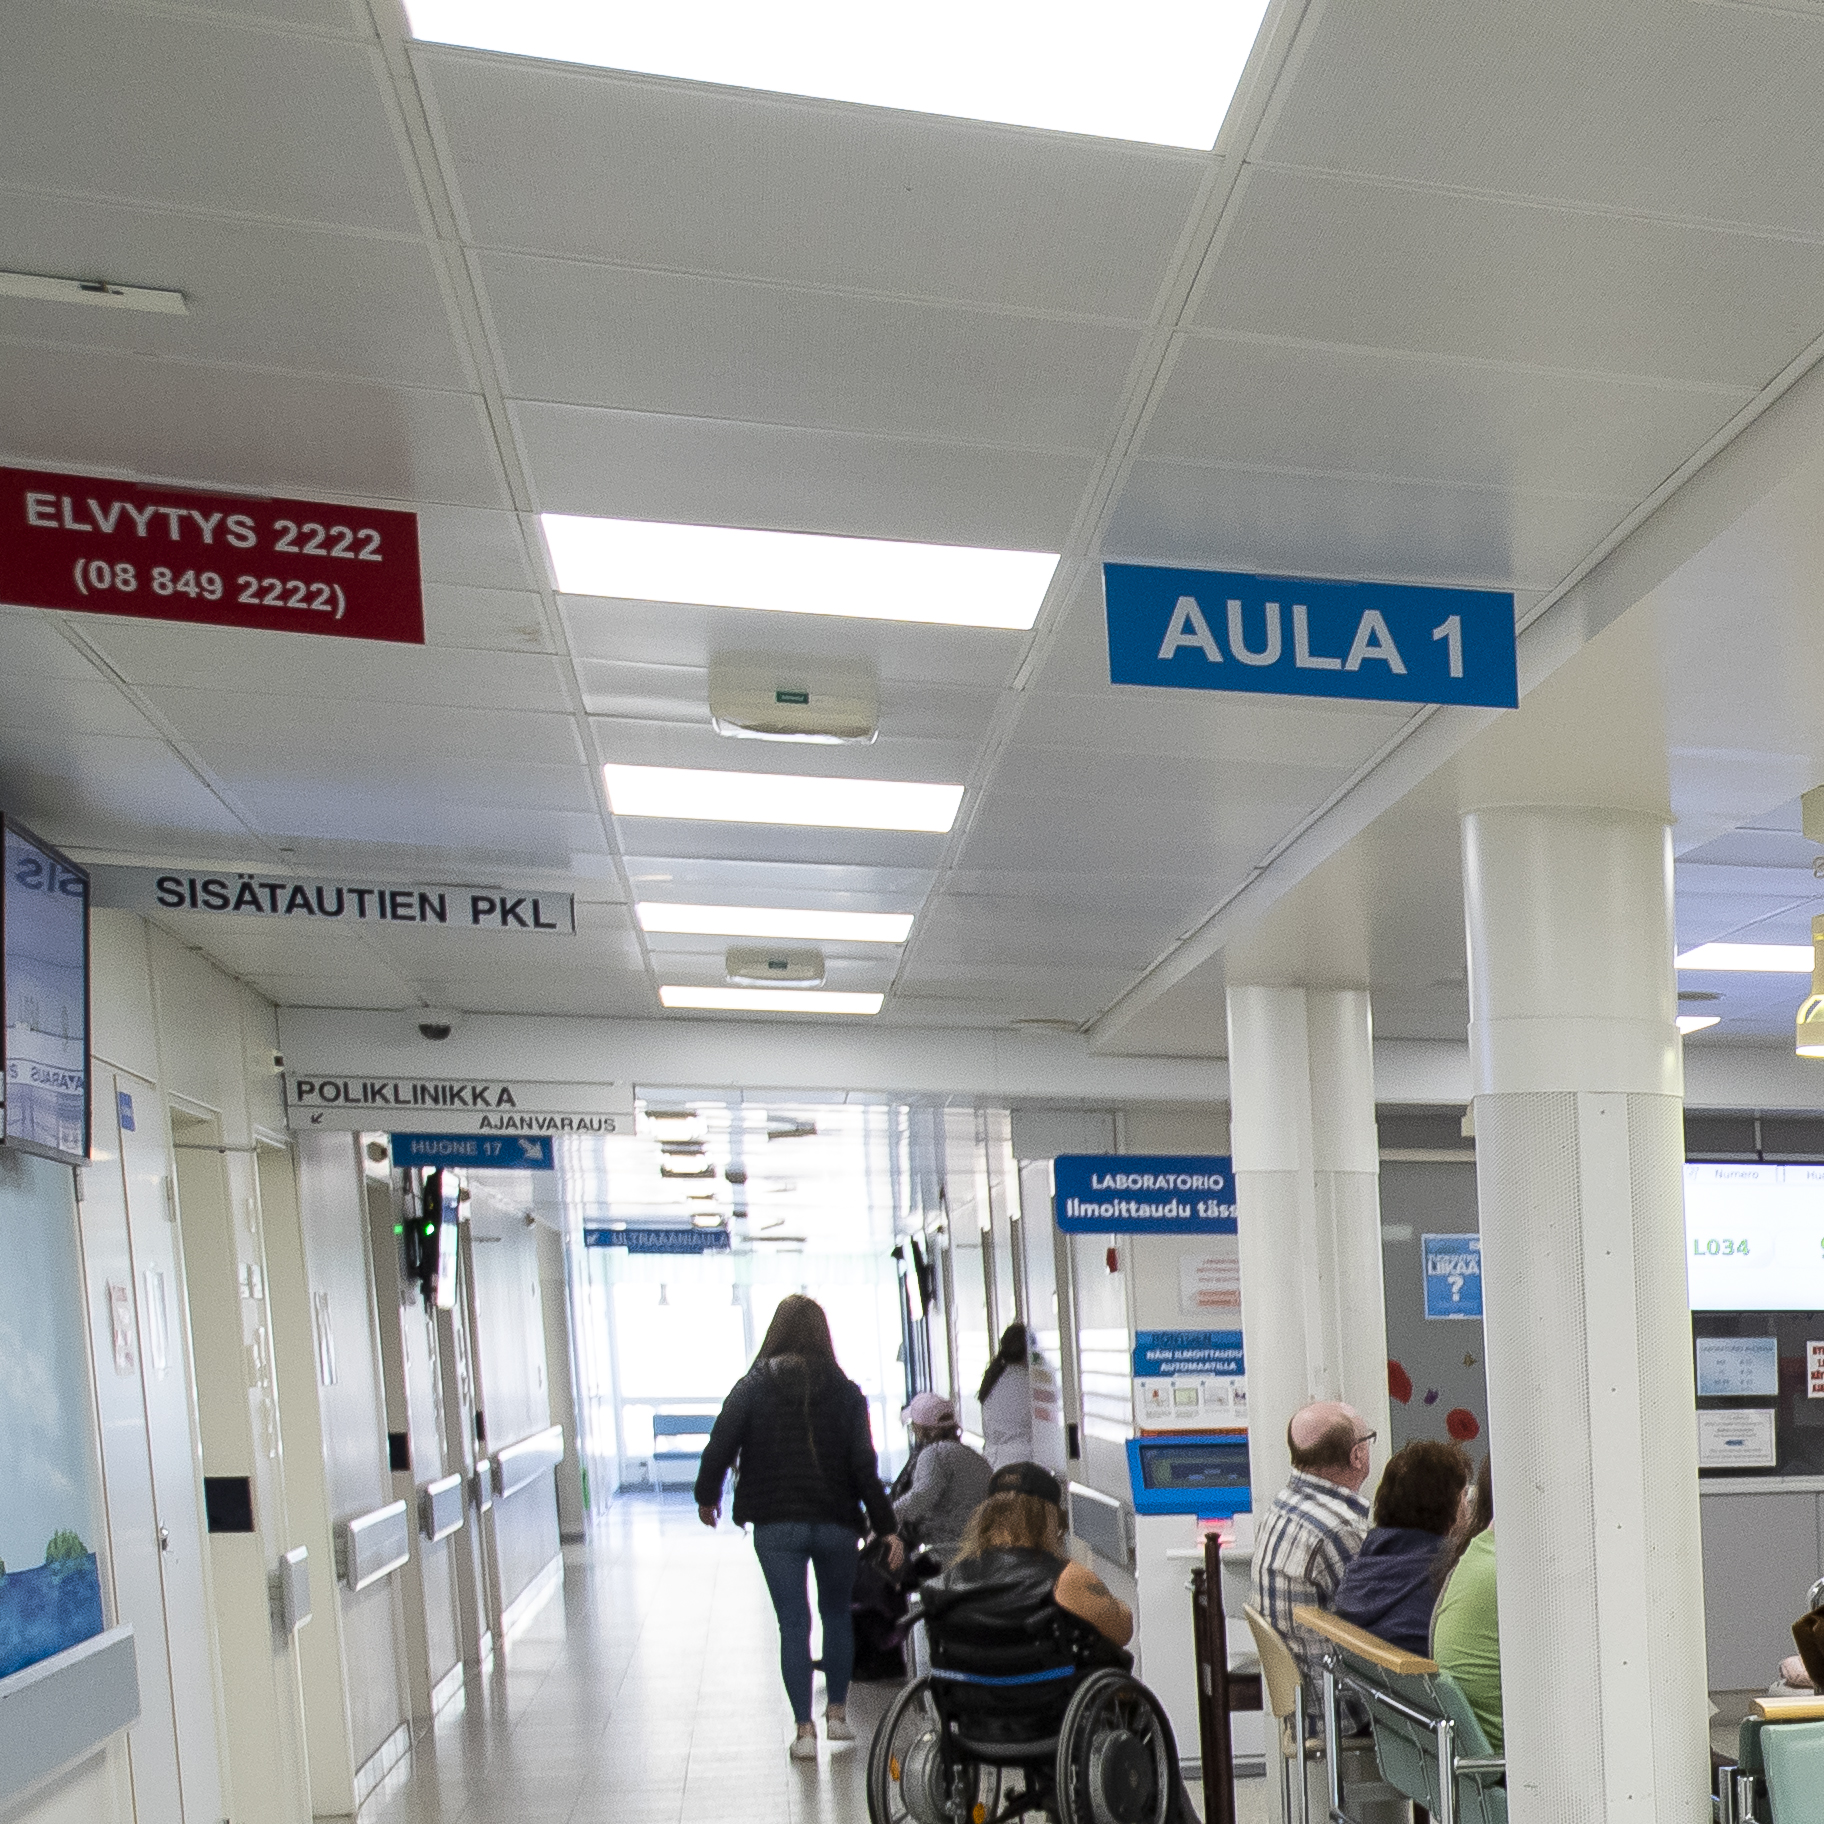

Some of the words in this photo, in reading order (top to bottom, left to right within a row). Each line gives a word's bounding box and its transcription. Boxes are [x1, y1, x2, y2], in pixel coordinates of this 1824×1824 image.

[25, 491, 258, 549] ELVYTYS
[273, 519, 383, 562] 2222
[73, 558, 138, 596] (08
[151, 566, 224, 601] 849
[236, 574, 347, 620] 2222)
[1157, 595, 1408, 674] AULA
[1431, 614, 1464, 679] 1
[155, 873, 447, 924] SISÄTAUTIEN
[470, 894, 558, 930] PKL
[296, 1080, 518, 1109] POLIKLINIKKA
[478, 1114, 617, 1133] AJANVARAUS
[410, 1139, 478, 1157] HUONE
[482, 1141, 503, 1157] 17
[1091, 1173, 1224, 1191] LABORATORIO
[1714, 1168, 1760, 1180] Numero
[1065, 1197, 1191, 1219] Ilmoittaudu
[1196, 1199, 1237, 1219] täss
[1693, 1238, 1751, 1256] L034
[1446, 1274, 1465, 1302] ?
